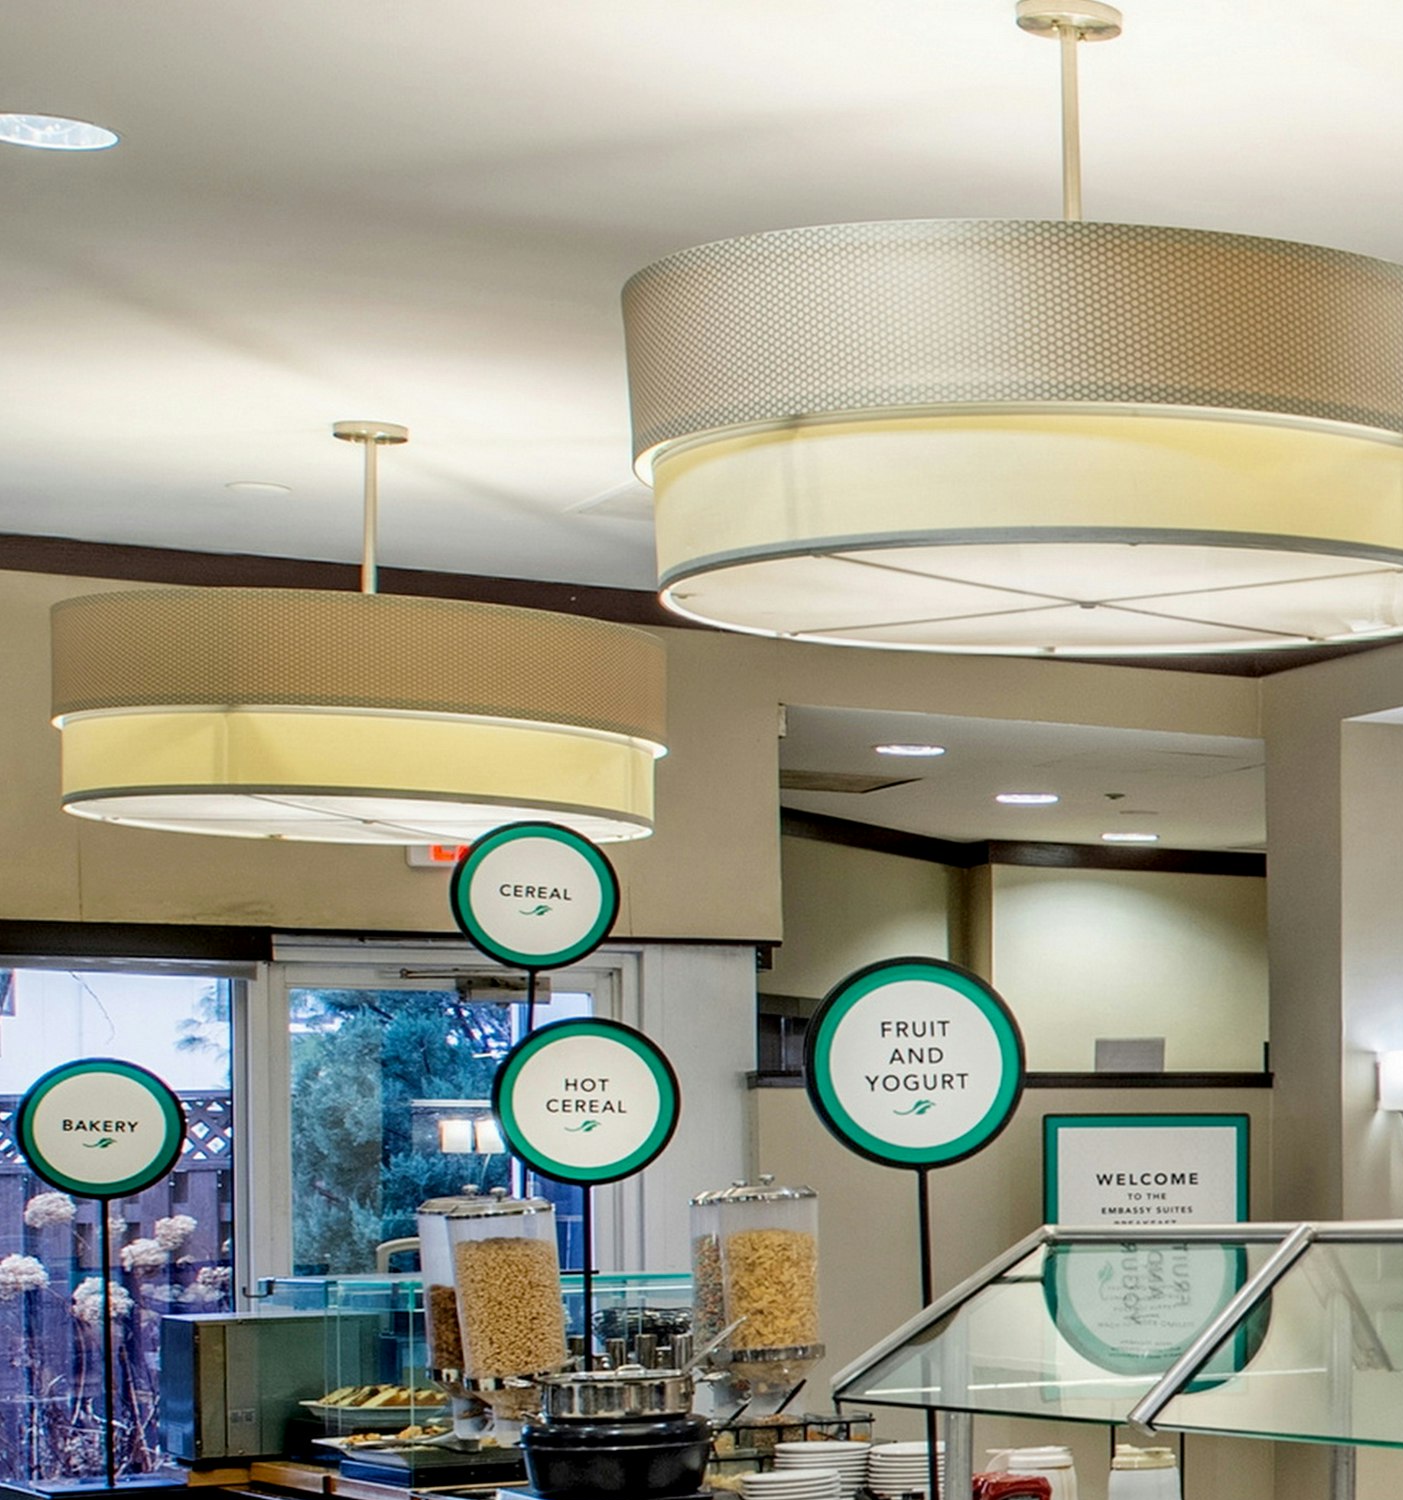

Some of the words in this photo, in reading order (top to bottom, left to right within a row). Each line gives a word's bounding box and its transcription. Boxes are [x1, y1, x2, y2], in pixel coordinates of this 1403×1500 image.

[499, 883, 572, 901] CEREAL
[881, 1020, 950, 1038] FRUIT
[889, 1047, 944, 1065] AND
[565, 1078, 609, 1093] HOT
[865, 1072, 969, 1093] YOGURT
[546, 1098, 627, 1114] CEREAL
[62, 1118, 139, 1133] BAKERY
[1096, 1172, 1199, 1187] WELCOME
[1127, 1192, 1142, 1201] TO
[1147, 1192, 1167, 1200] THE
[1101, 1206, 1151, 1215] EMBASSY
[1156, 1205, 1193, 1215] SUITES
